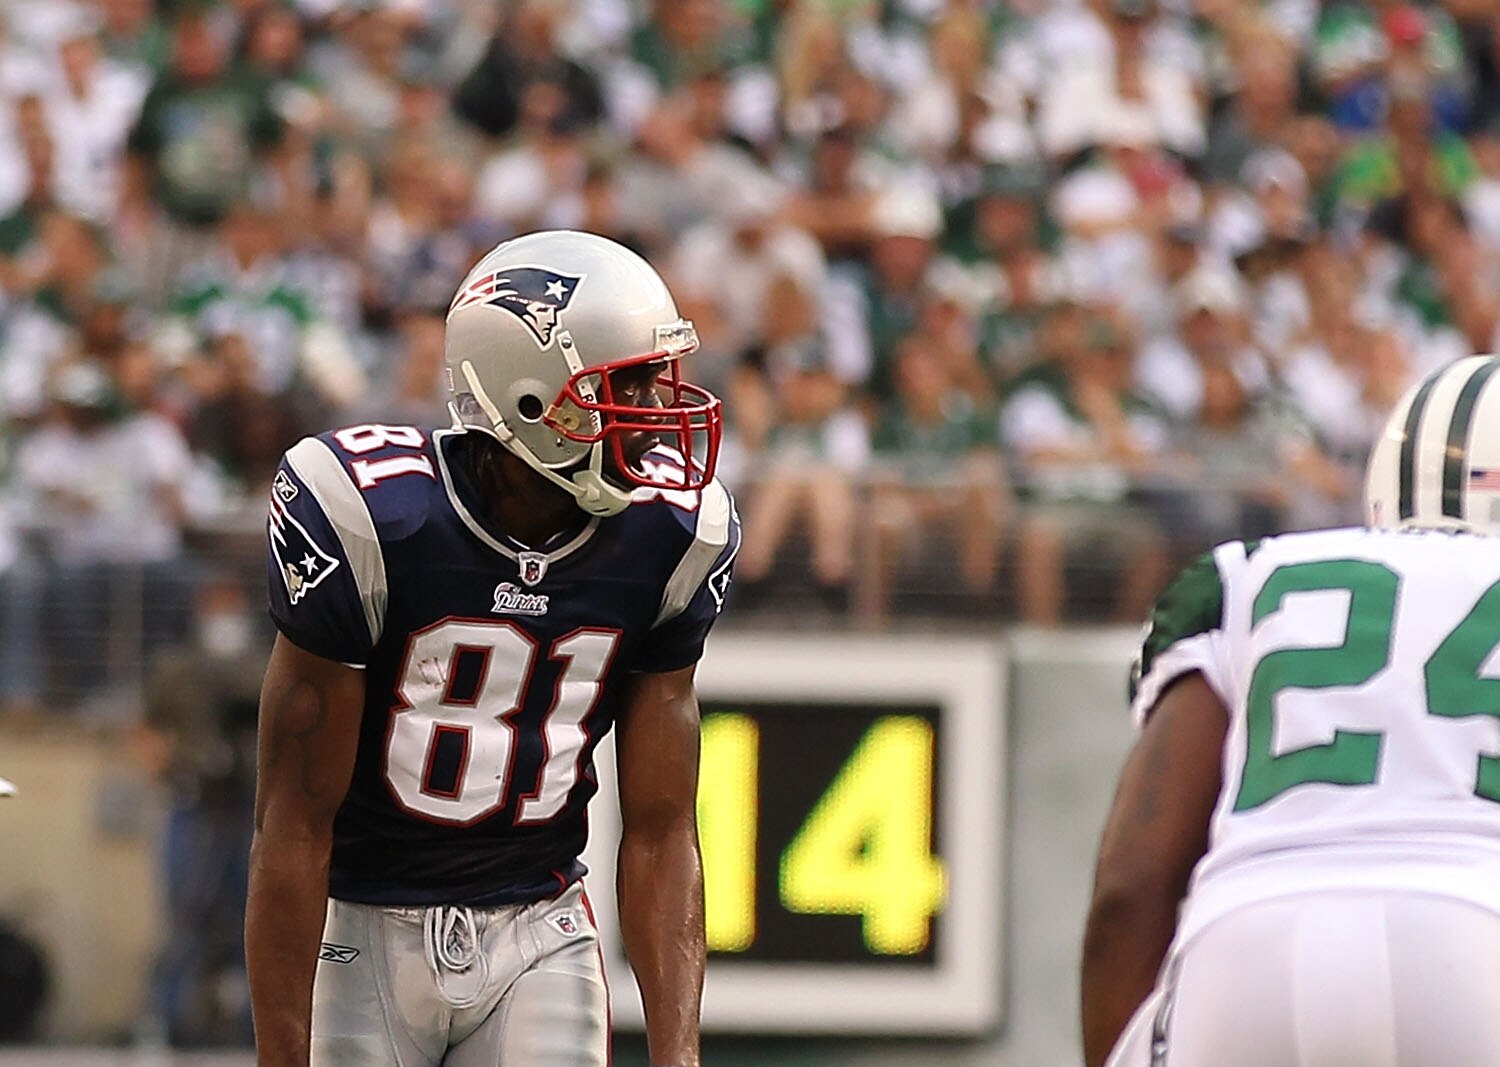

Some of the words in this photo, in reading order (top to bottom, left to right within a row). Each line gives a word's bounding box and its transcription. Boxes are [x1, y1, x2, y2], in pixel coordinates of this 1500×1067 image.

[332, 423, 437, 491] 81
[380, 615, 624, 829] 81
[696, 711, 949, 956] 14
